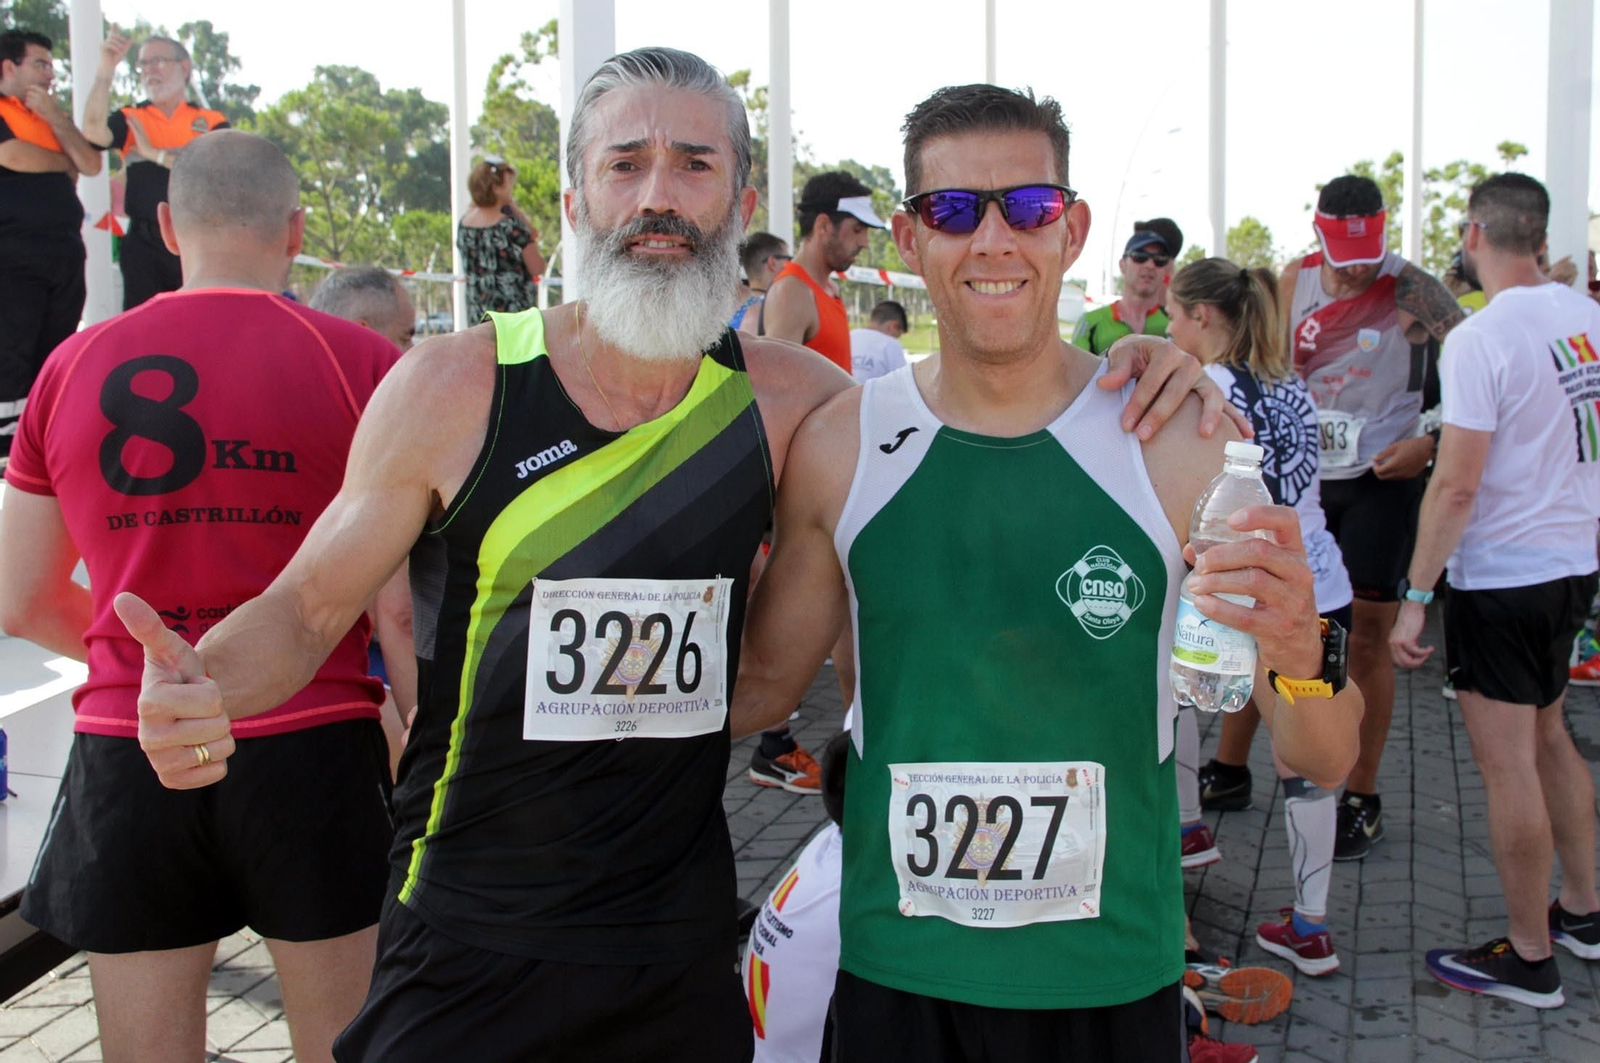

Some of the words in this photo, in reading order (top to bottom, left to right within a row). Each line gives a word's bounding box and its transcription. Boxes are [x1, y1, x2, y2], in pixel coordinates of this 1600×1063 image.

[99, 354, 206, 496] 8
[211, 440, 298, 473] Km
[107, 513, 138, 530] DE
[145, 505, 301, 527] CASTRILLÓN
[542, 588, 595, 599] DIRECCIÓN
[597, 591, 645, 601] GENERAL
[648, 592, 661, 602] DE
[663, 592, 673, 602] LA
[1176, 623, 1215, 647] Natura
[545, 608, 703, 695] 3226
[535, 700, 634, 716] AGRUPACIÓN
[638, 697, 710, 715] DEPORTIVA
[614, 720, 638, 733] 3226
[945, 775, 989, 785] GENERAL
[991, 775, 1004, 785] DE
[1006, 775, 1020, 785] LA
[1023, 773, 1063, 785] POLICÍA
[906, 793, 1070, 881] 3227
[907, 880, 990, 901] AGRUPACIÓN
[994, 884, 1078, 901] DEPORTIVA
[971, 907, 996, 921] 3227
